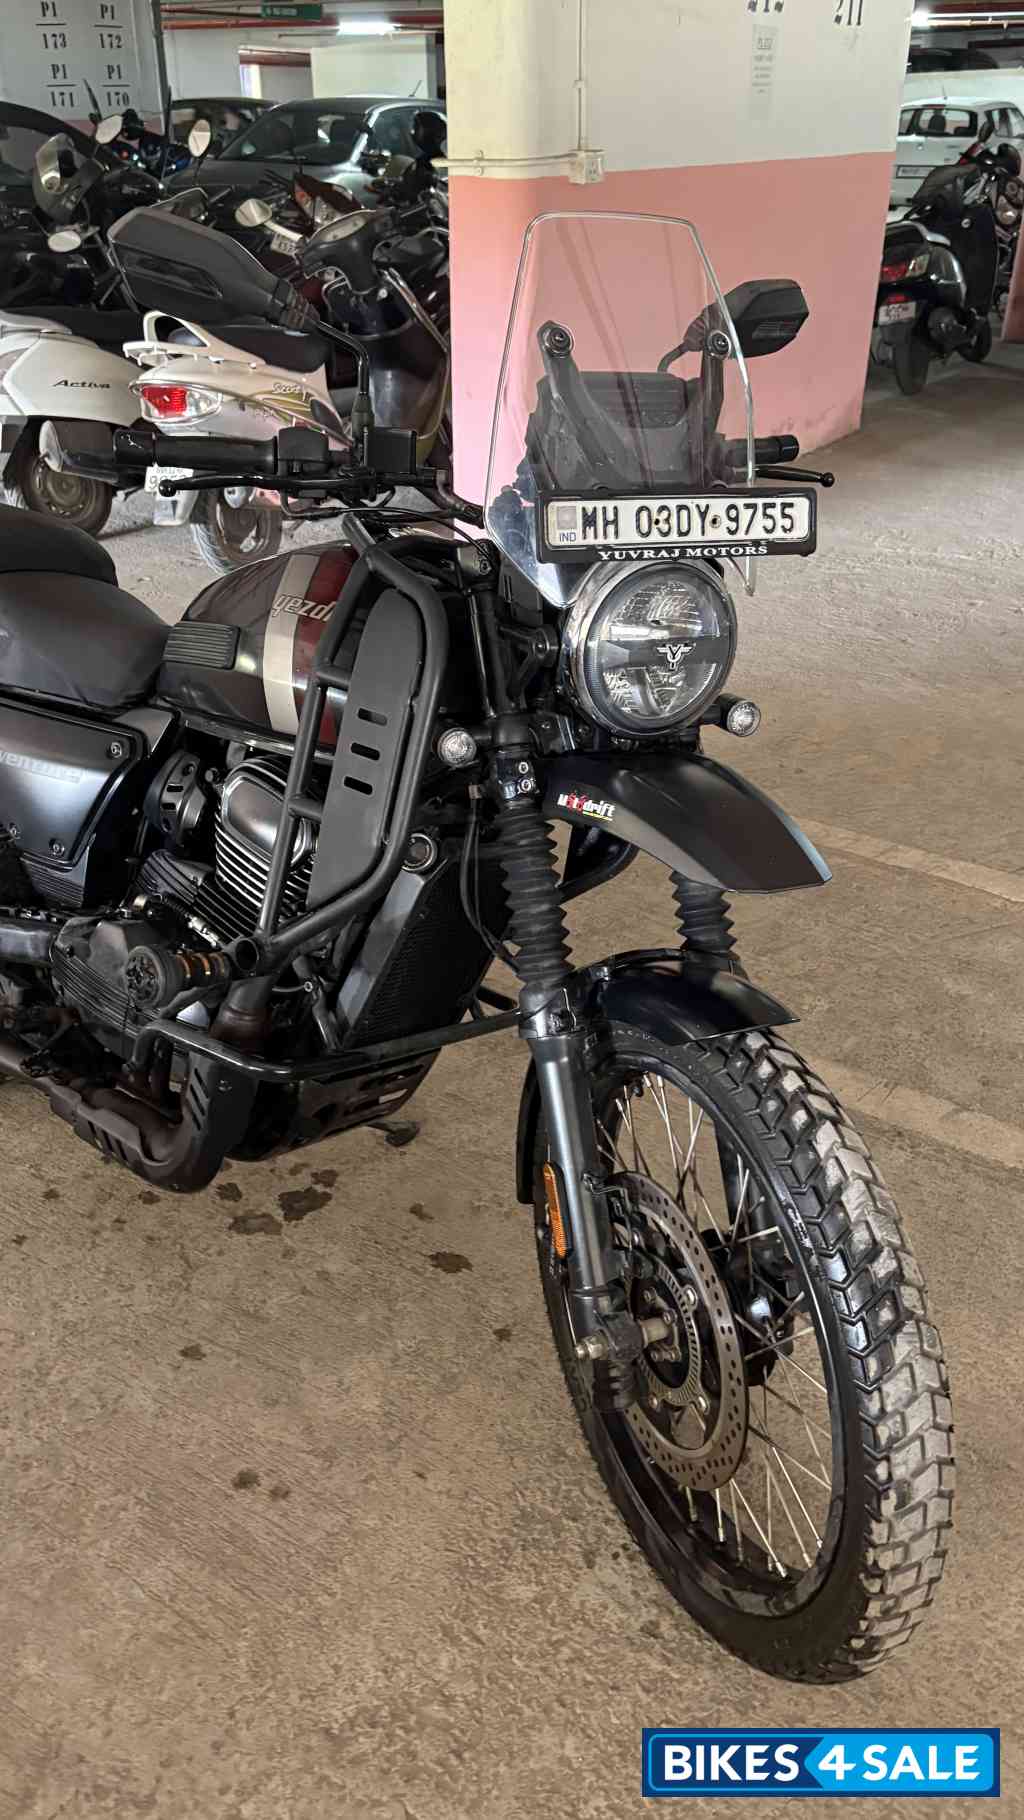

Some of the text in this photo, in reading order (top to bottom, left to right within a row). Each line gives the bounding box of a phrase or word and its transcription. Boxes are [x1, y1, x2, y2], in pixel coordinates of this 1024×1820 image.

[41, 1, 57, 17] P1
[100, 4, 115, 20] P1
[42, 33, 67, 49] 173
[99, 33, 123, 49] 172
[51, 64, 67, 79] P1
[107, 64, 122, 79] P1
[51, 91, 74, 107] 171
[107, 91, 130, 107] 170
[52, 379, 110, 389] Activa
[581, 502, 795, 541] MH 03DY 9755
[559, 532, 577, 543] IND
[598, 545, 768, 561] YUVRAJ MOTORS
